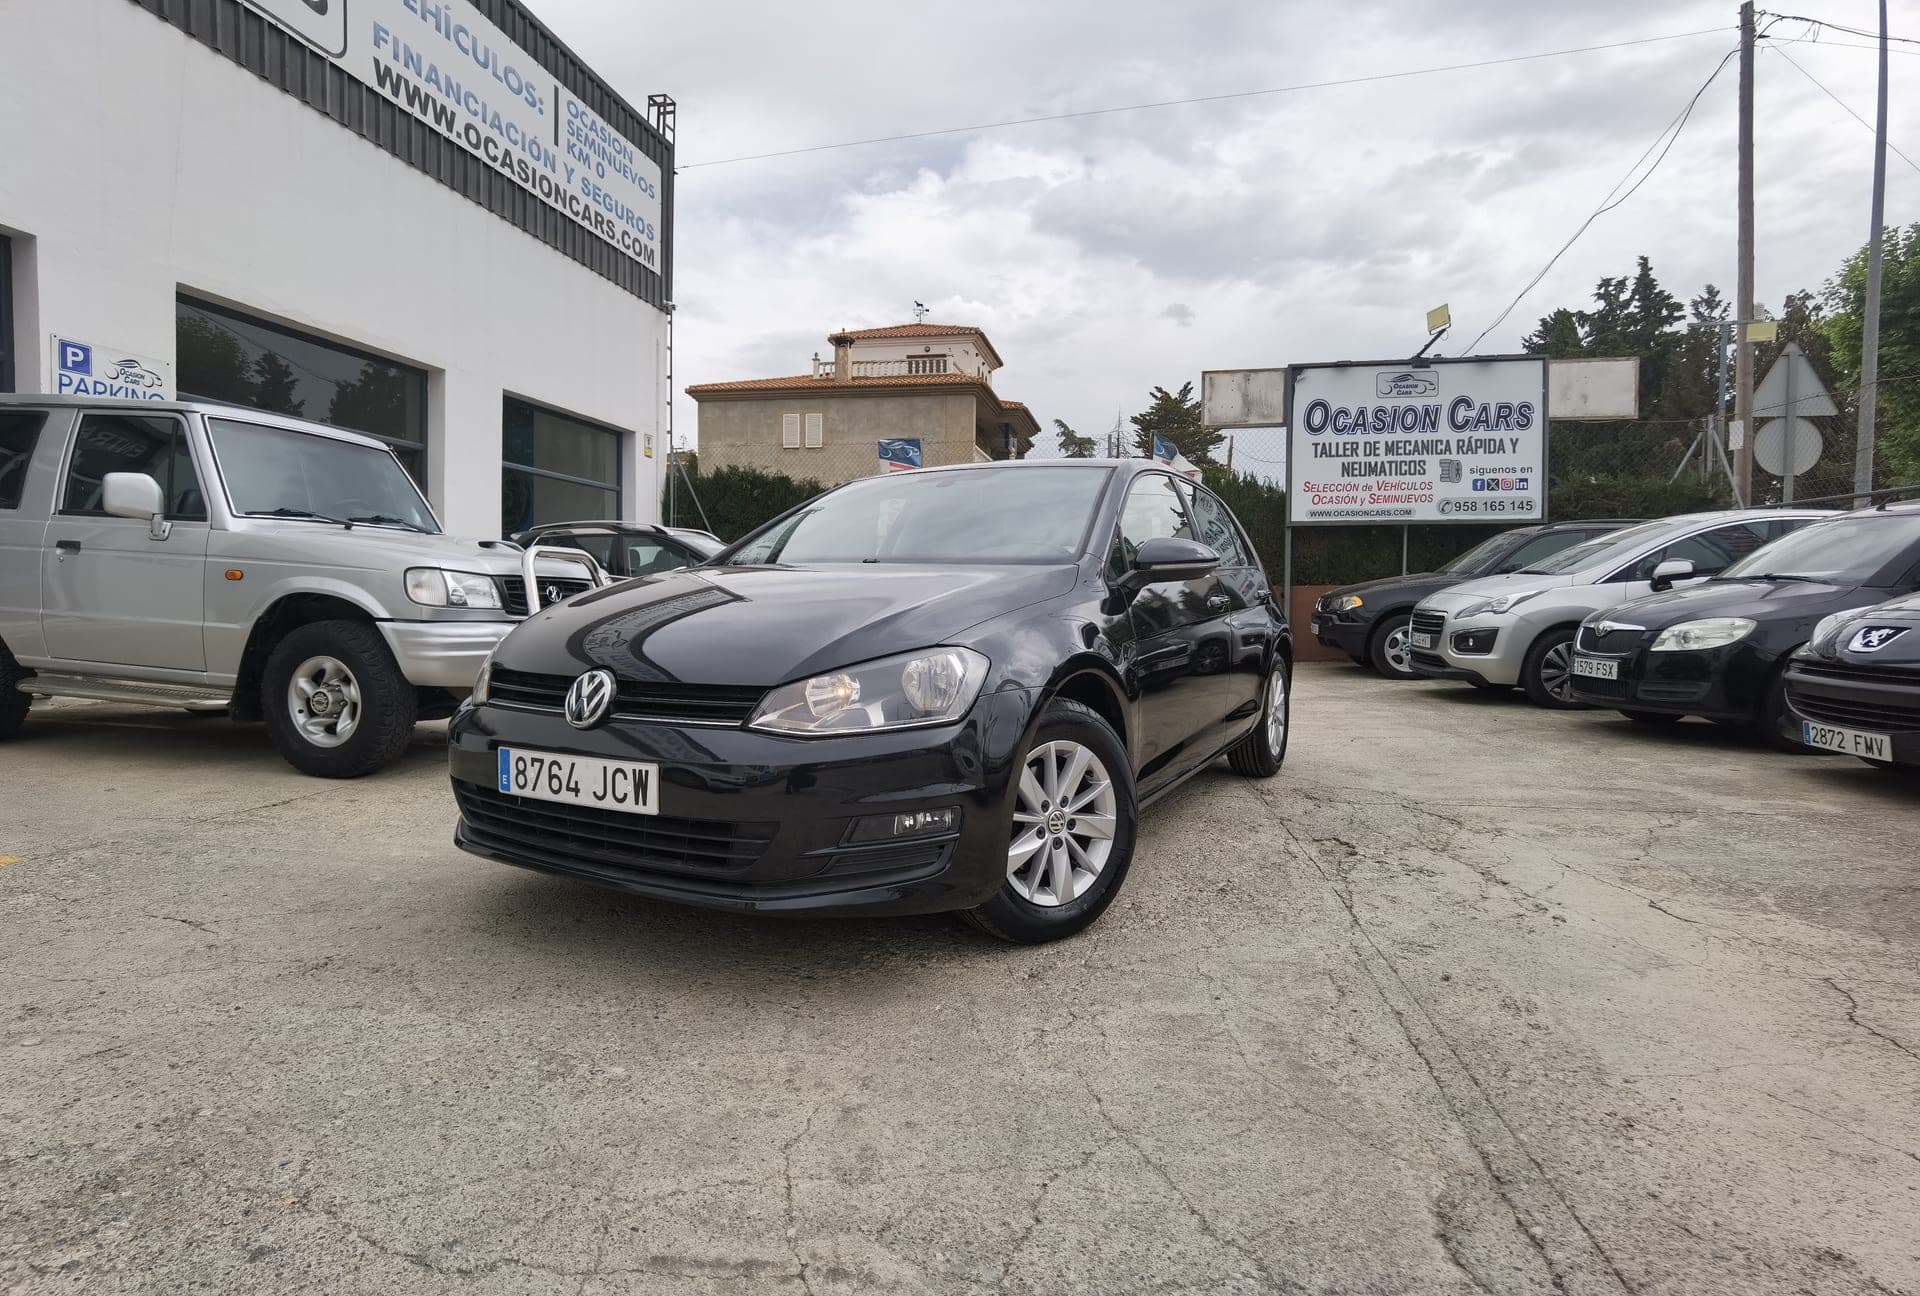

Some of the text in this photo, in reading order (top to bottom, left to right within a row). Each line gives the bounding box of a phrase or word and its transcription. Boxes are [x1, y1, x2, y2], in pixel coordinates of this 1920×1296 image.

[373, 21, 655, 241] FINANCIACIÓN Y SEGUROS
[566, 100, 633, 165] OCASION
[373, 56, 655, 267] WWW.OCASIONCARS.COM
[566, 138, 592, 170] KM
[566, 119, 655, 199] SEMINUEVOS
[1303, 395, 1535, 435] OCASION CARS
[1312, 436, 1520, 458] TALLER DE MECANICA RÁPIDA Y
[1341, 460, 1426, 477] NEUMATICOS
[1469, 465, 1517, 476] siguenos
[1303, 480, 1433, 493] SELECCIÓN de VEHÍCULOS
[1311, 493, 1434, 506] OCASIÓN y SEMINUEVOS
[1309, 508, 1412, 518] WWW.OCASIONCARS.COM
[1454, 500, 1534, 512] 958 165 145
[1576, 659, 1614, 677] 1579 FSX
[1811, 726, 1883, 757] 2872 FMV
[514, 756, 649, 806] 8764 JCW
